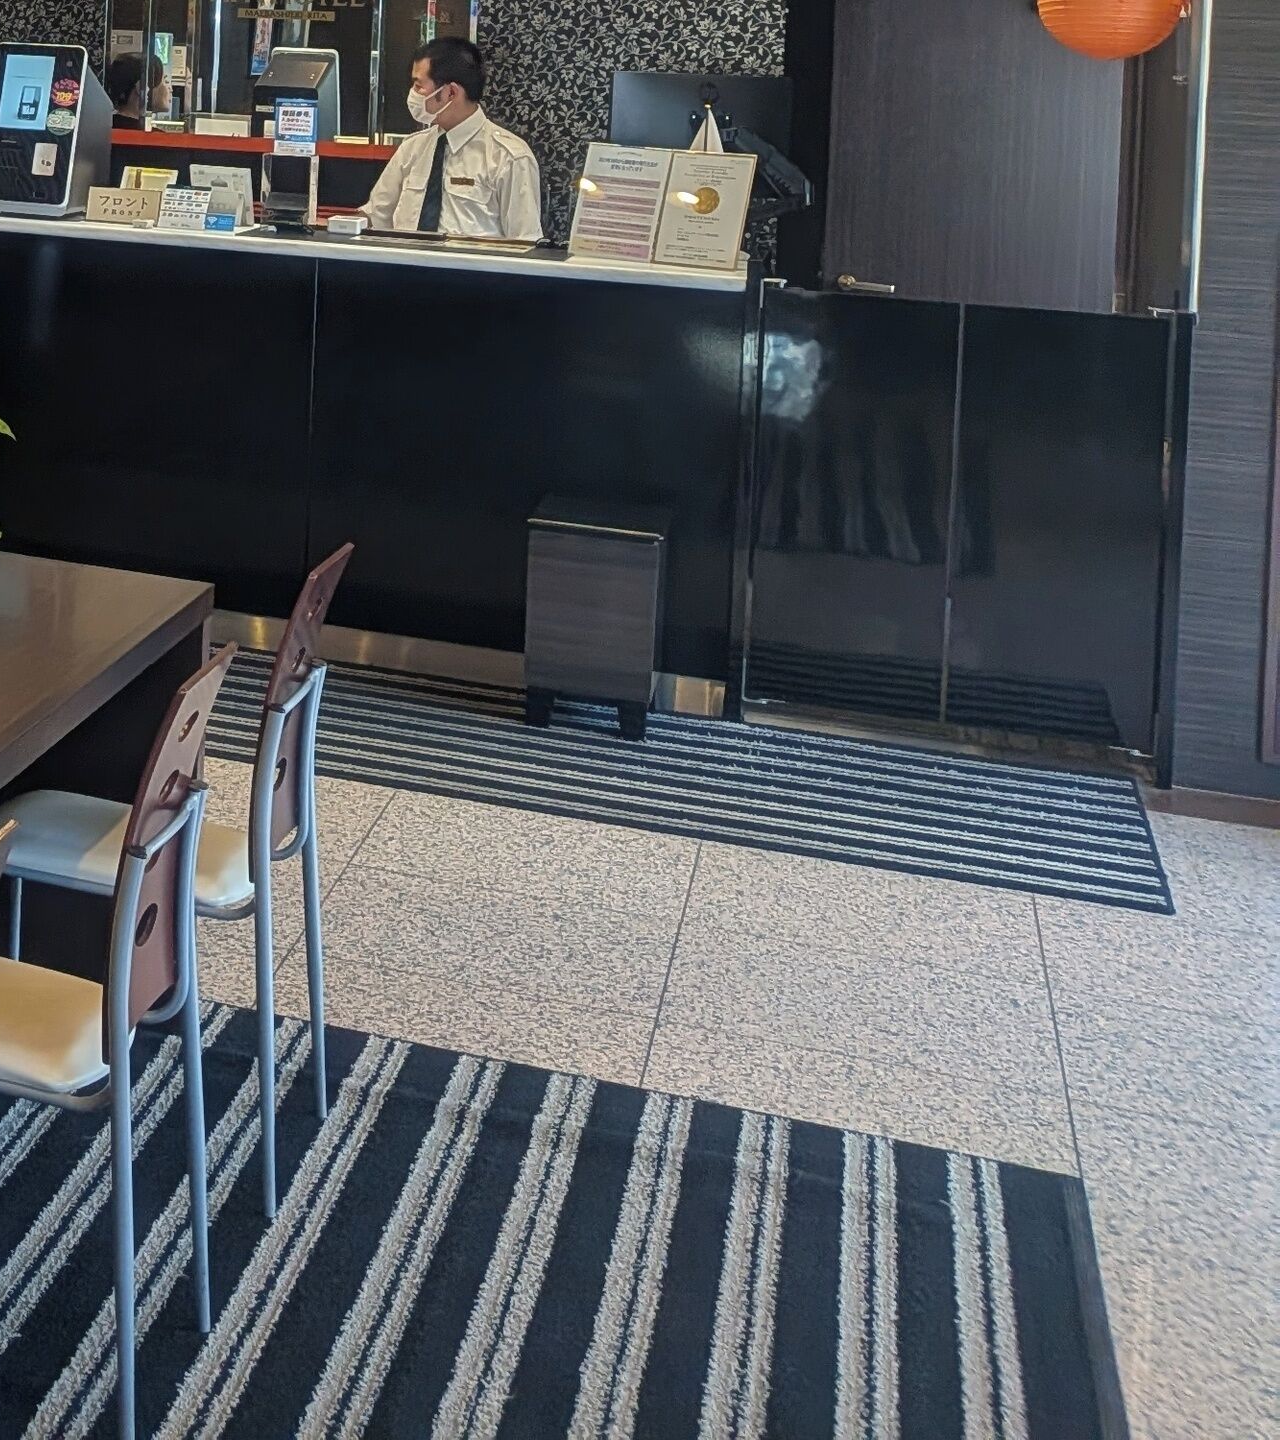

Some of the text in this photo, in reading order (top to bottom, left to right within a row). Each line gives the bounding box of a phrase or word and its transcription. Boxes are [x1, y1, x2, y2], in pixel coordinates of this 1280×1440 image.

[99, 195, 149, 210] フロント
[103, 208, 142, 217] FRONT
